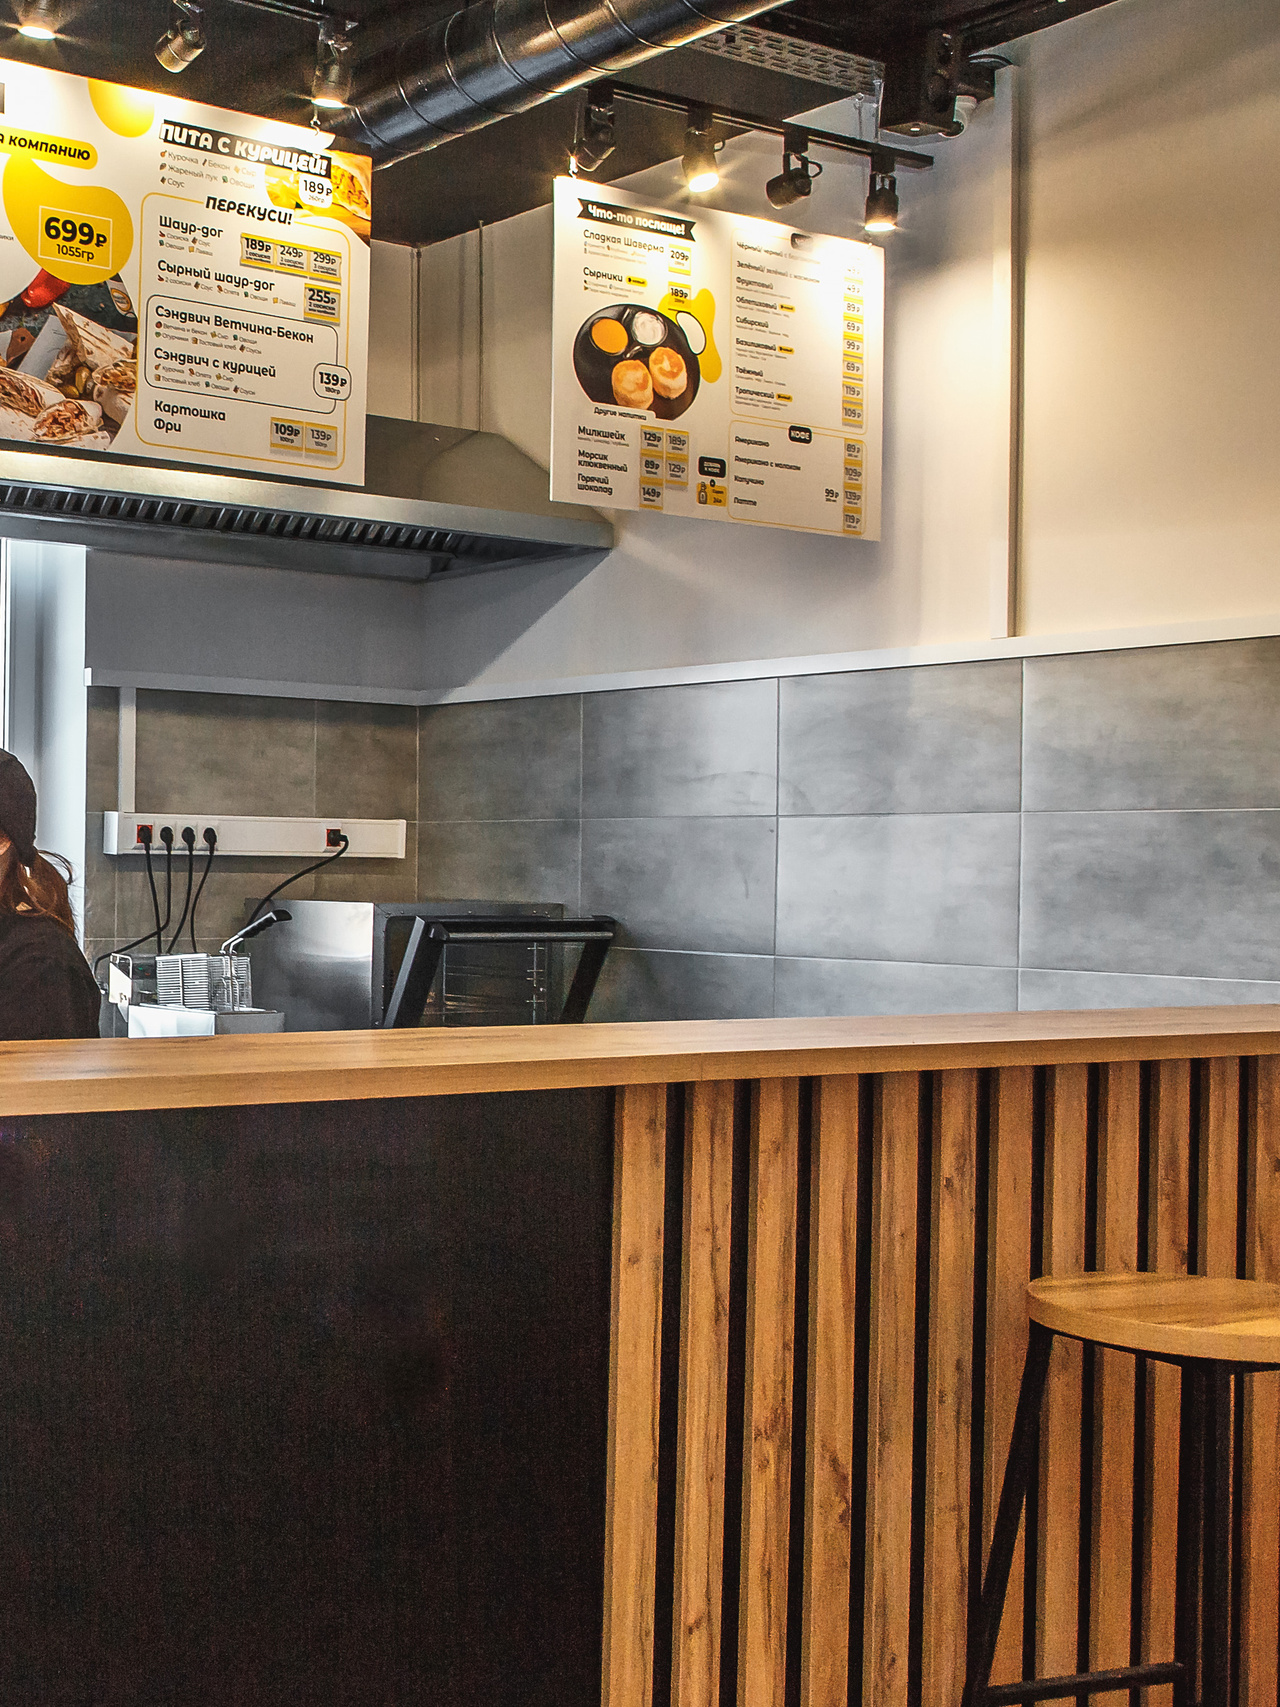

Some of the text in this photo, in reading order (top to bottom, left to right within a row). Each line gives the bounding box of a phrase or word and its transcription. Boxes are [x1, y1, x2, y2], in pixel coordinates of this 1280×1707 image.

[8, 136, 91, 161] КОМПАНИЮ
[160, 123, 213, 150] ПИТА
[234, 140, 328, 175] КУРИЦЕЙ!
[206, 196, 292, 225] ПЕРЕКУСИ!
[588, 204, 685, 235] Что-то послаще!
[159, 215, 223, 238] Шаур-дог
[583, 229, 664, 253] Сладкая Шаверма
[56, 244, 94, 262] 1055гр
[158, 260, 275, 291] Сырный шаур-дог
[583, 267, 623, 282] Сырники
[155, 306, 314, 343] Сэндвич Ветчина-Бекон
[154, 348, 276, 378] Сэндвич с курицей
[154, 400, 226, 421] Картошка
[154, 418, 181, 434] Фри
[578, 426, 626, 441] Милкшейк
[578, 450, 608, 461] Морсик
[578, 460, 628, 472] клюквенный
[577, 474, 609, 485] Горячий
[577, 484, 613, 495] шоколад
